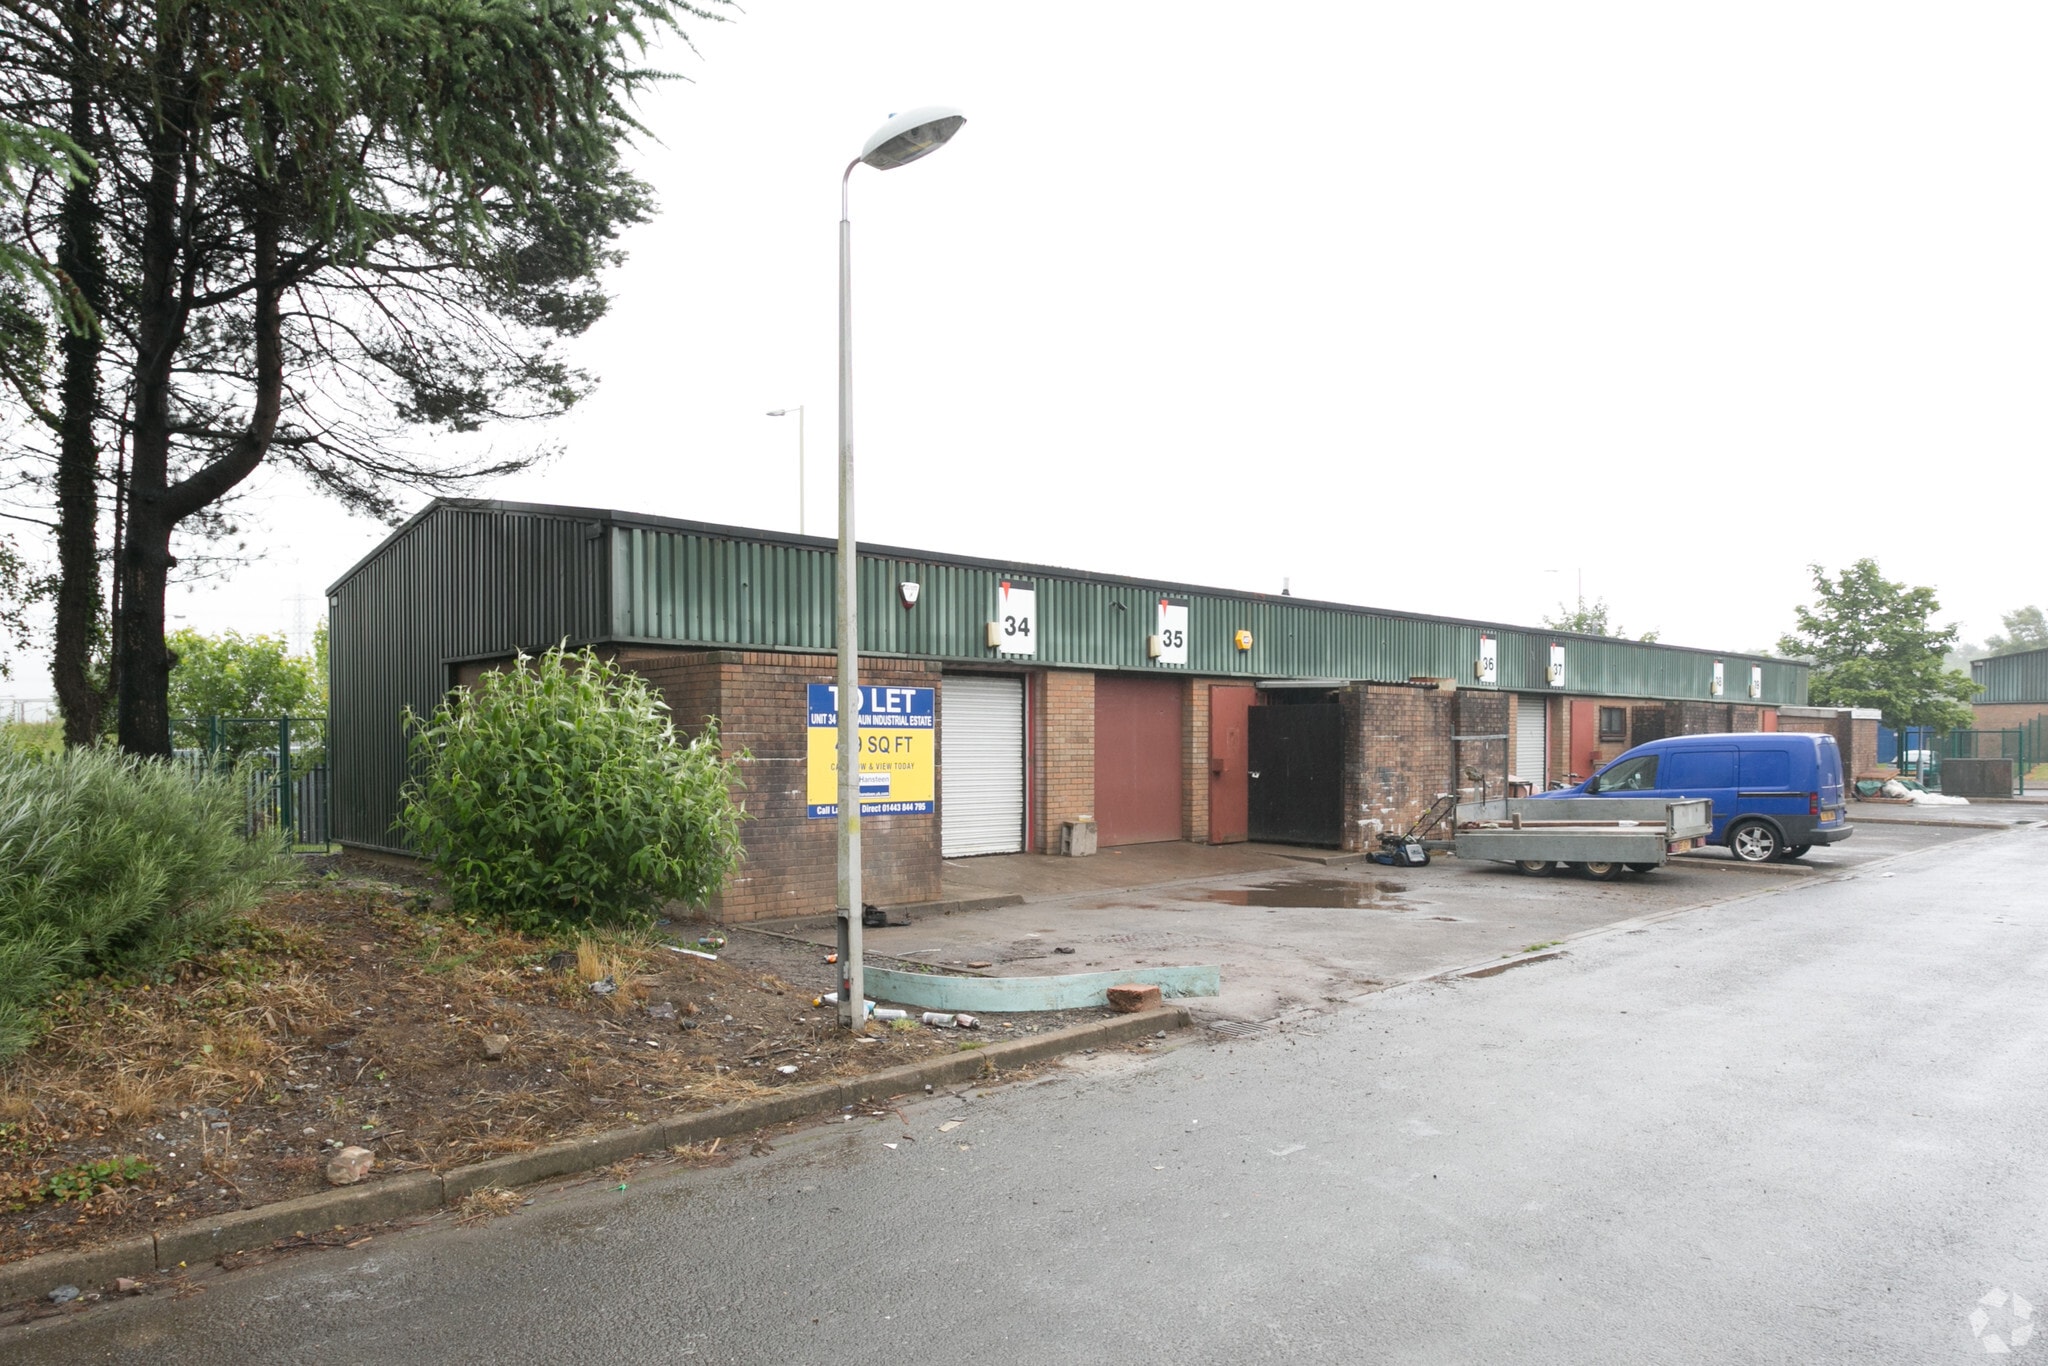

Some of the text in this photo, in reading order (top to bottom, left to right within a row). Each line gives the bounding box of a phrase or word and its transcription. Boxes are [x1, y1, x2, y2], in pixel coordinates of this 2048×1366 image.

[1004, 615, 1030, 637] 34
[1162, 629, 1183, 649] 35
[1483, 657, 1494, 671] 36
[1553, 663, 1562, 676] 37
[828, 686, 916, 713] T LET
[810, 713, 827, 724] UNIT
[828, 714, 836, 724] 34
[872, 715, 909, 726] INDUSTRIAL
[909, 715, 932, 726] ESTATE
[867, 735, 890, 753] SQ
[895, 736, 913, 753] FT
[868, 762, 874, 770] &
[875, 762, 892, 770] VIEW
[894, 762, 914, 770] TODAY
[816, 806, 830, 814] Call
[861, 804, 881, 813] Direct
[881, 803, 901, 812] 01443
